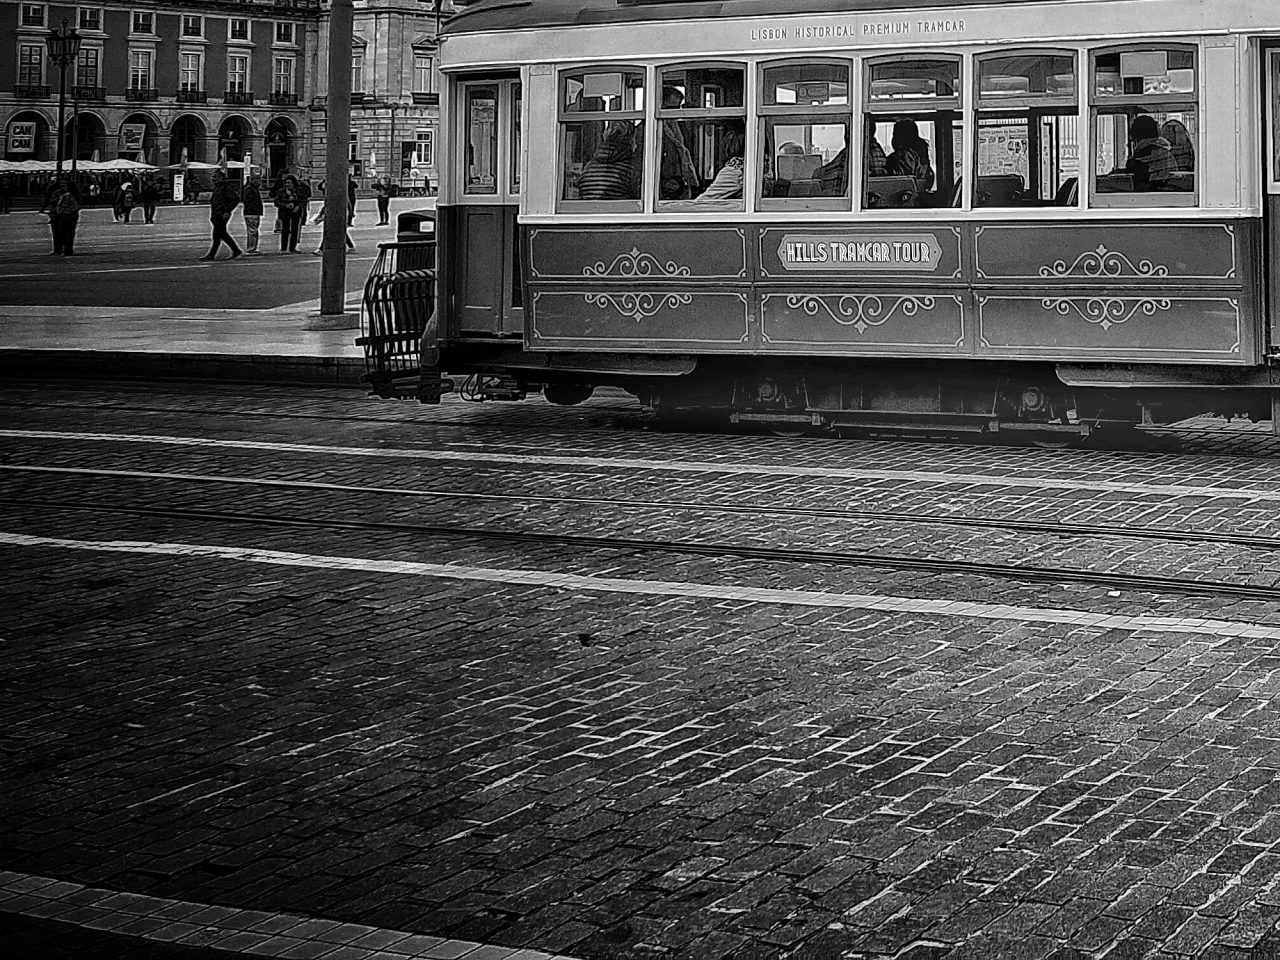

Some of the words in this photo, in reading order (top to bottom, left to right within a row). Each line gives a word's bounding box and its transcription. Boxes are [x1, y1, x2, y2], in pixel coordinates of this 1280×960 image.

[751, 28, 787, 40] LISBON
[795, 25, 855, 38] HISTORICAL
[863, 22, 909, 35] PREMIUM
[917, 20, 965, 32] TRAMCAR
[13, 125, 33, 136] CAN
[12, 138, 31, 149] CAN
[786, 242, 828, 262] HILLS
[830, 242, 891, 262] TRAMCAR
[893, 242, 930, 262] TOUR
